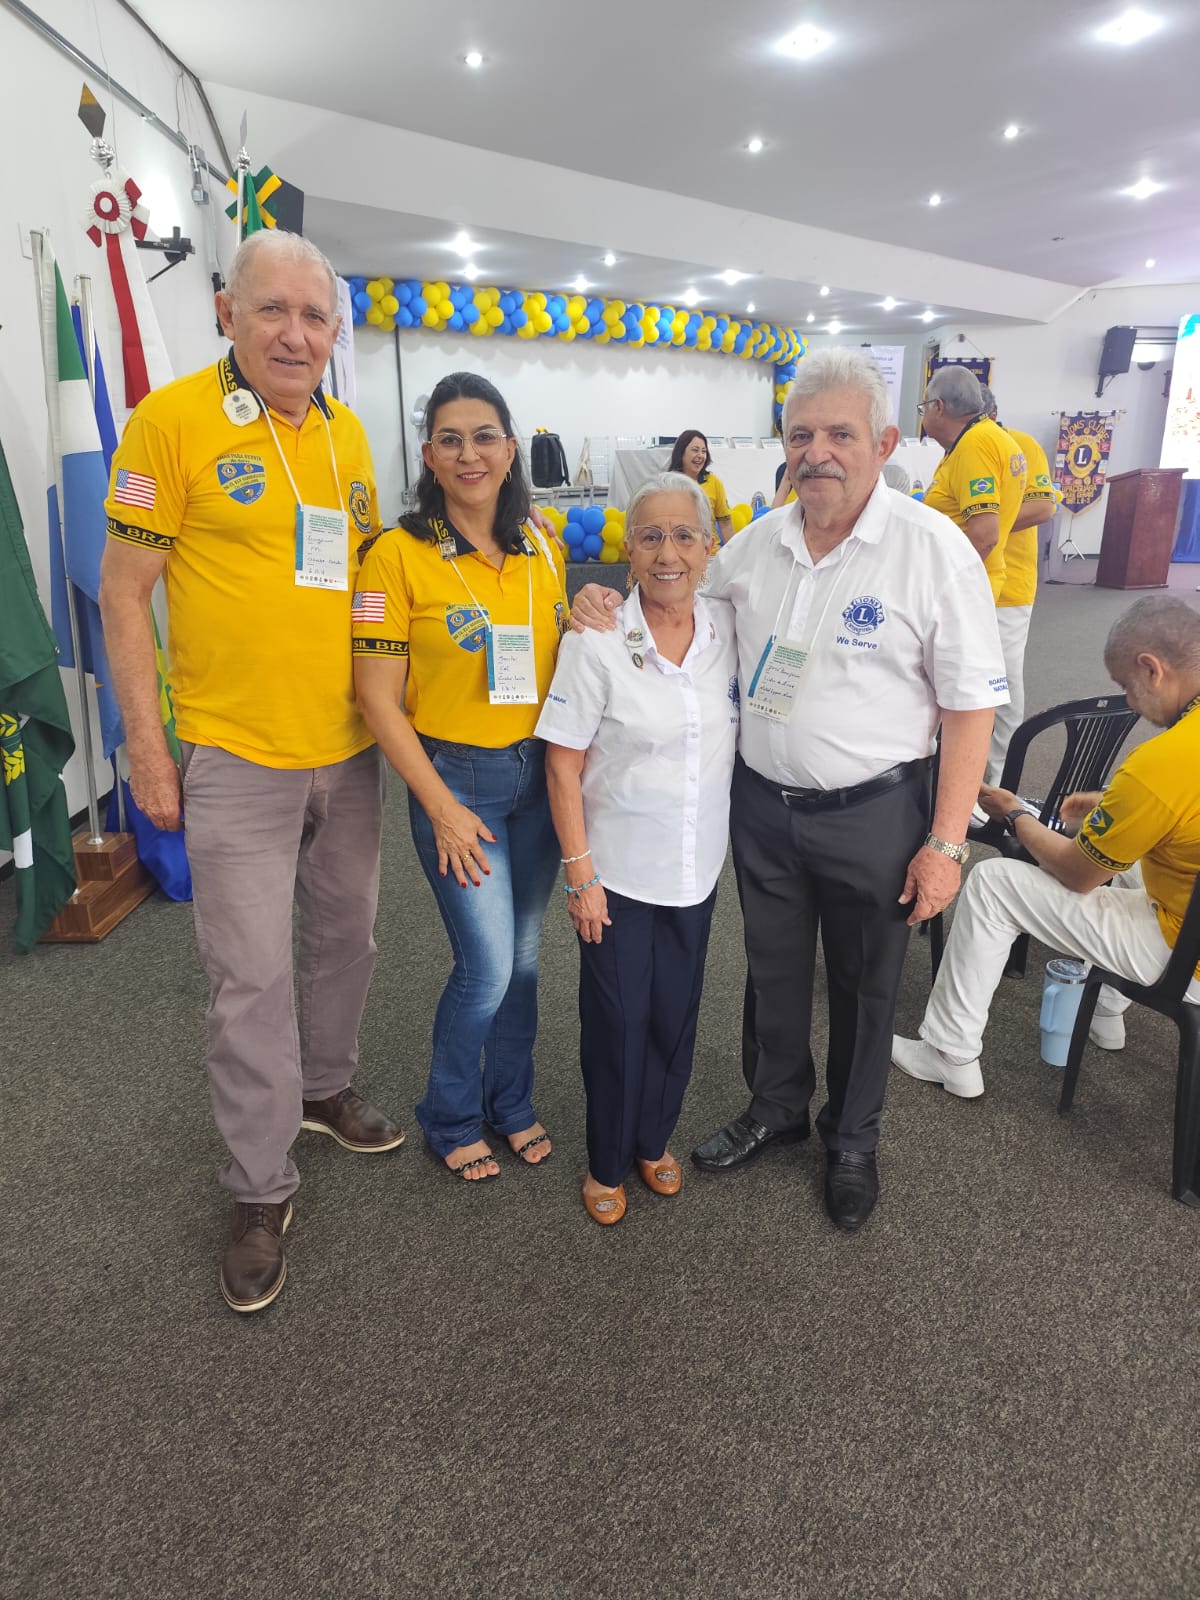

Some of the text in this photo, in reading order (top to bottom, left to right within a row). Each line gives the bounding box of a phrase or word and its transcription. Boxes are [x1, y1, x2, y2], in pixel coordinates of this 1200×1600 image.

[1076, 447, 1088, 465] L
[126, 527, 176, 547] BRA
[856, 607, 870, 622] L
[836, 635, 878, 650] We Serve
